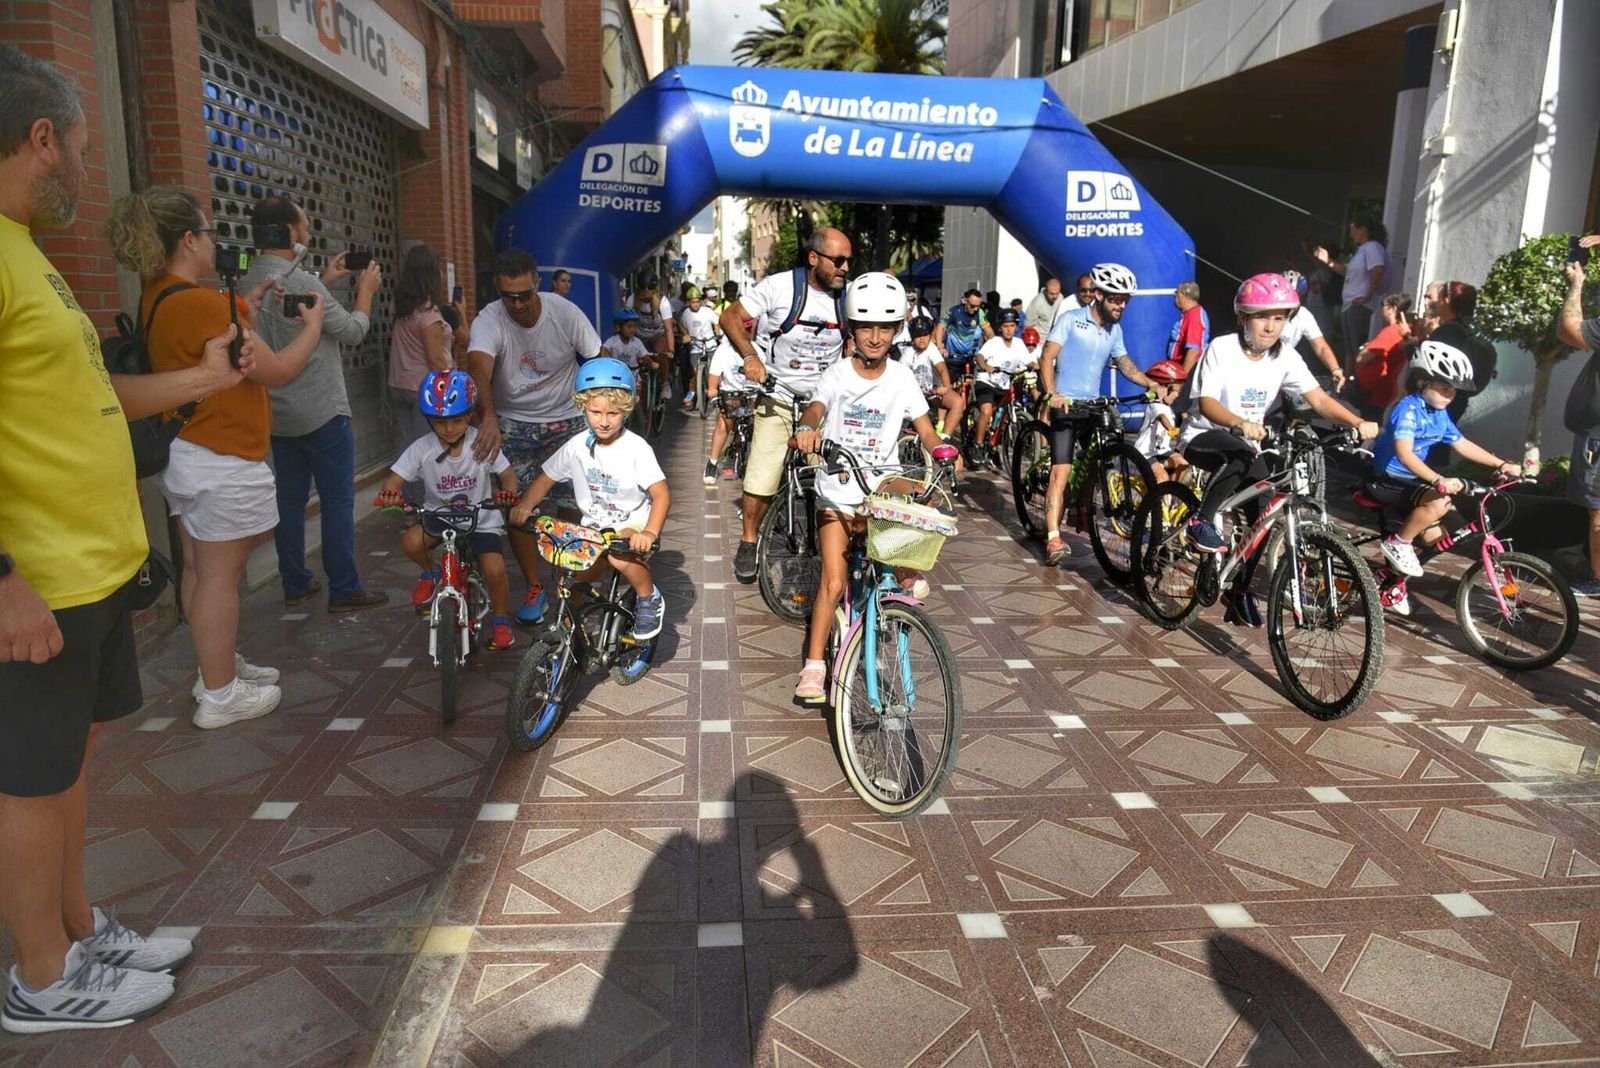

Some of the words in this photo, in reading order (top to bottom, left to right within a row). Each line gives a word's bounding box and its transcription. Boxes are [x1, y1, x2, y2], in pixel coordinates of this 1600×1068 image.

[781, 89, 998, 126] Ayuntamiento
[804, 126, 842, 155] de
[848, 128, 885, 157] La
[890, 132, 974, 163] Línea
[592, 153, 613, 173] D
[580, 182, 635, 193] DELEGACIÓN
[637, 186, 649, 195] DE
[1077, 181, 1096, 203] D
[579, 193, 662, 213] DEPORTES
[1065, 211, 1118, 220] DELEGACIÓN
[1119, 211, 1130, 219] DE
[1065, 222, 1144, 237] DEPORTES
